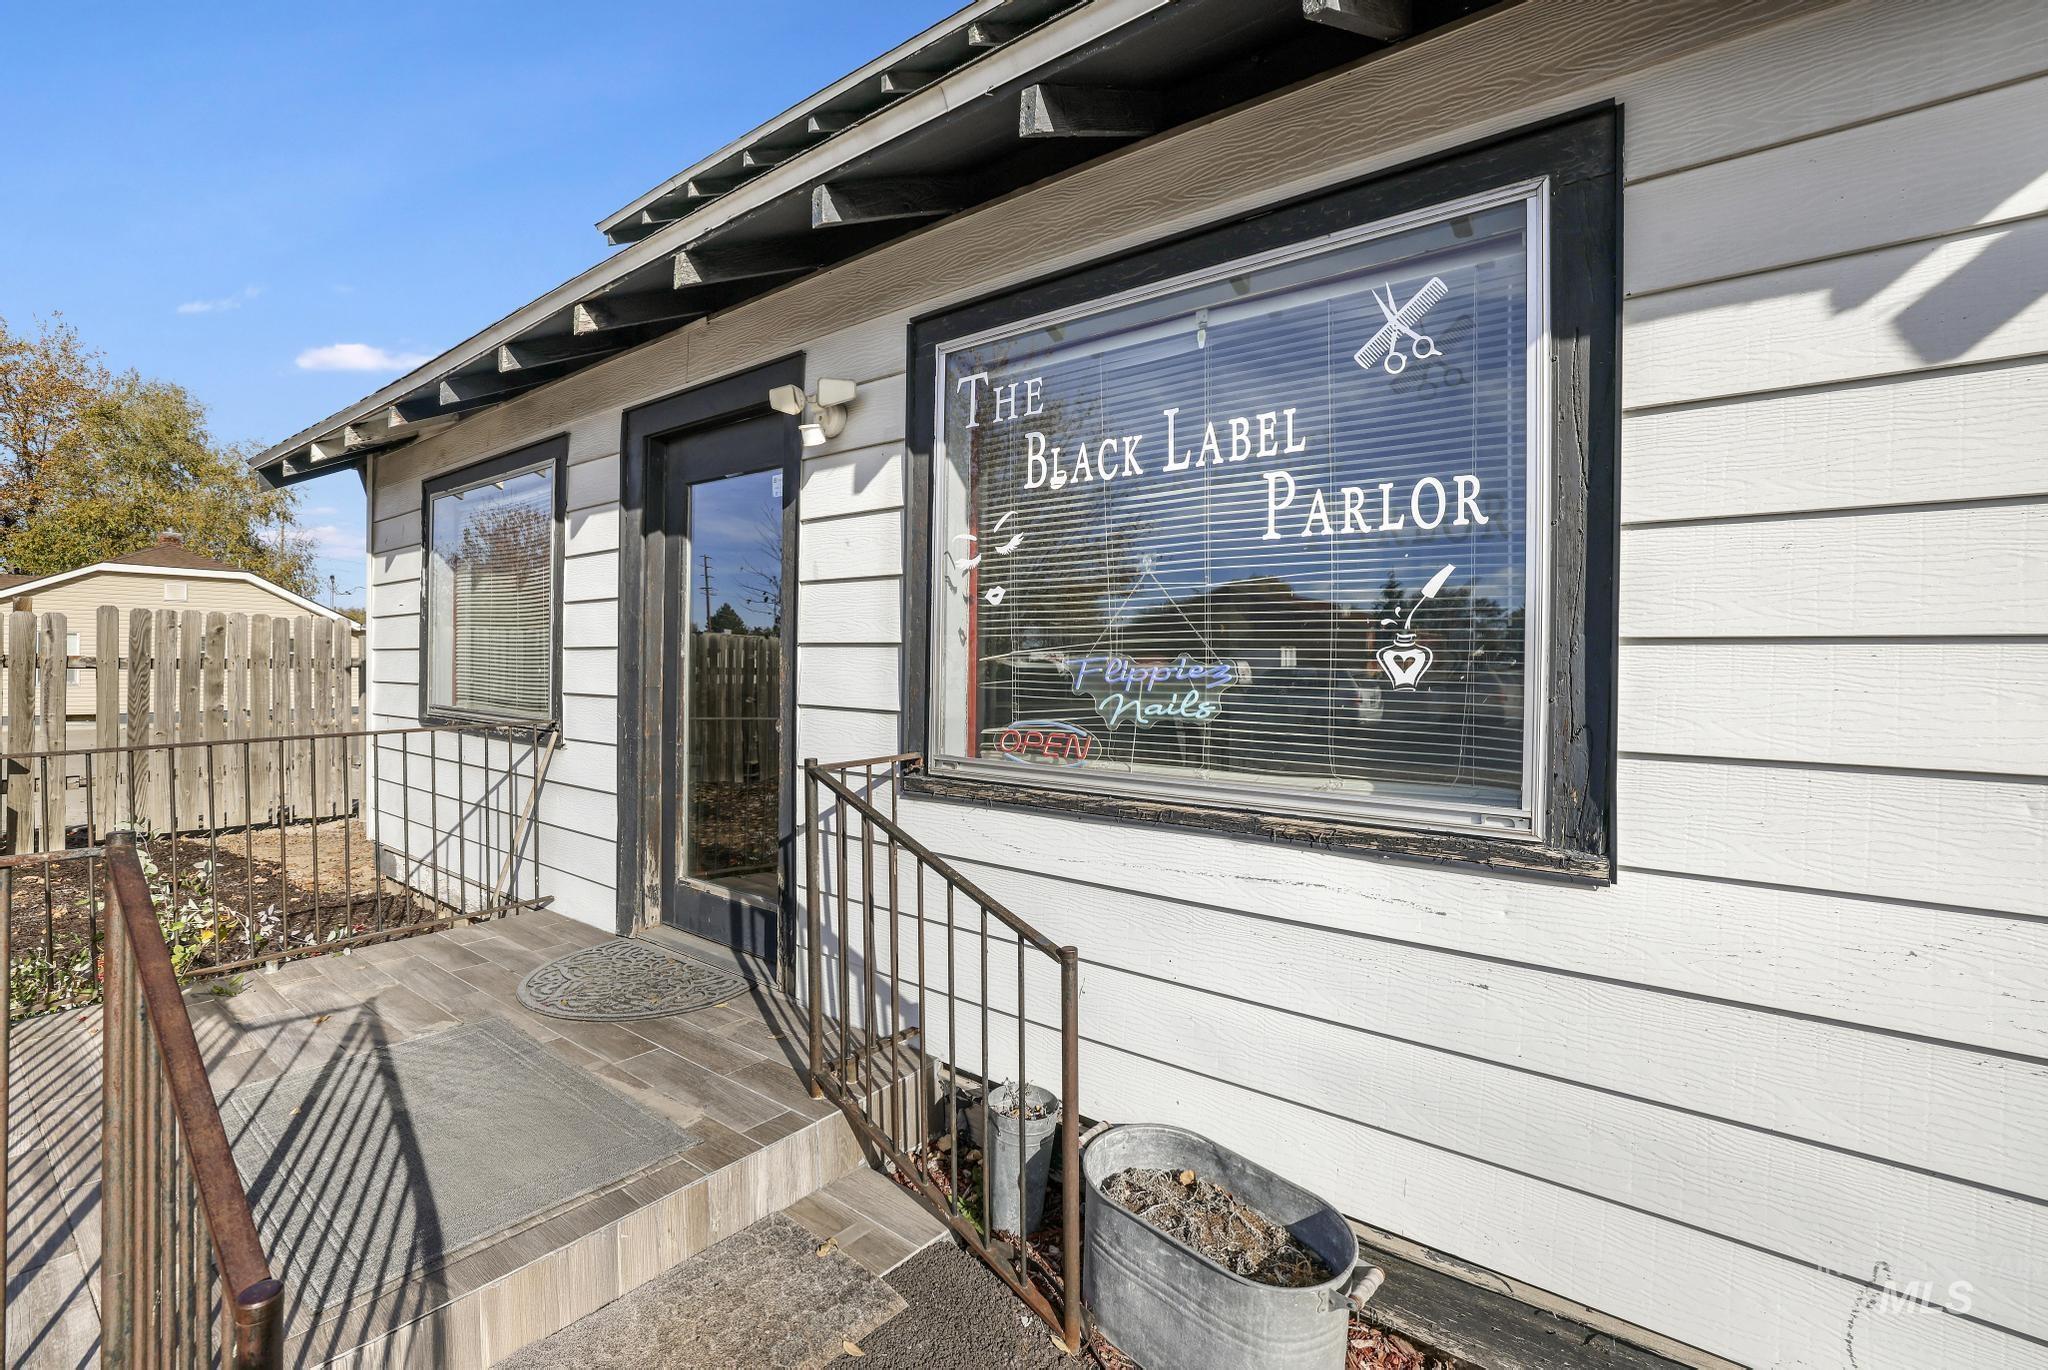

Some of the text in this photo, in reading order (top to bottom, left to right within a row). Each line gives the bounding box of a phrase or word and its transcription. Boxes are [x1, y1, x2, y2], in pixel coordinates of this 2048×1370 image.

[957, 372, 1044, 429] THE
[1023, 407, 1306, 490] BLACK LABEL
[1262, 471, 1489, 541] PARLOR
[1098, 689, 1217, 725] Nails
[1000, 729, 1092, 760] OPEN
